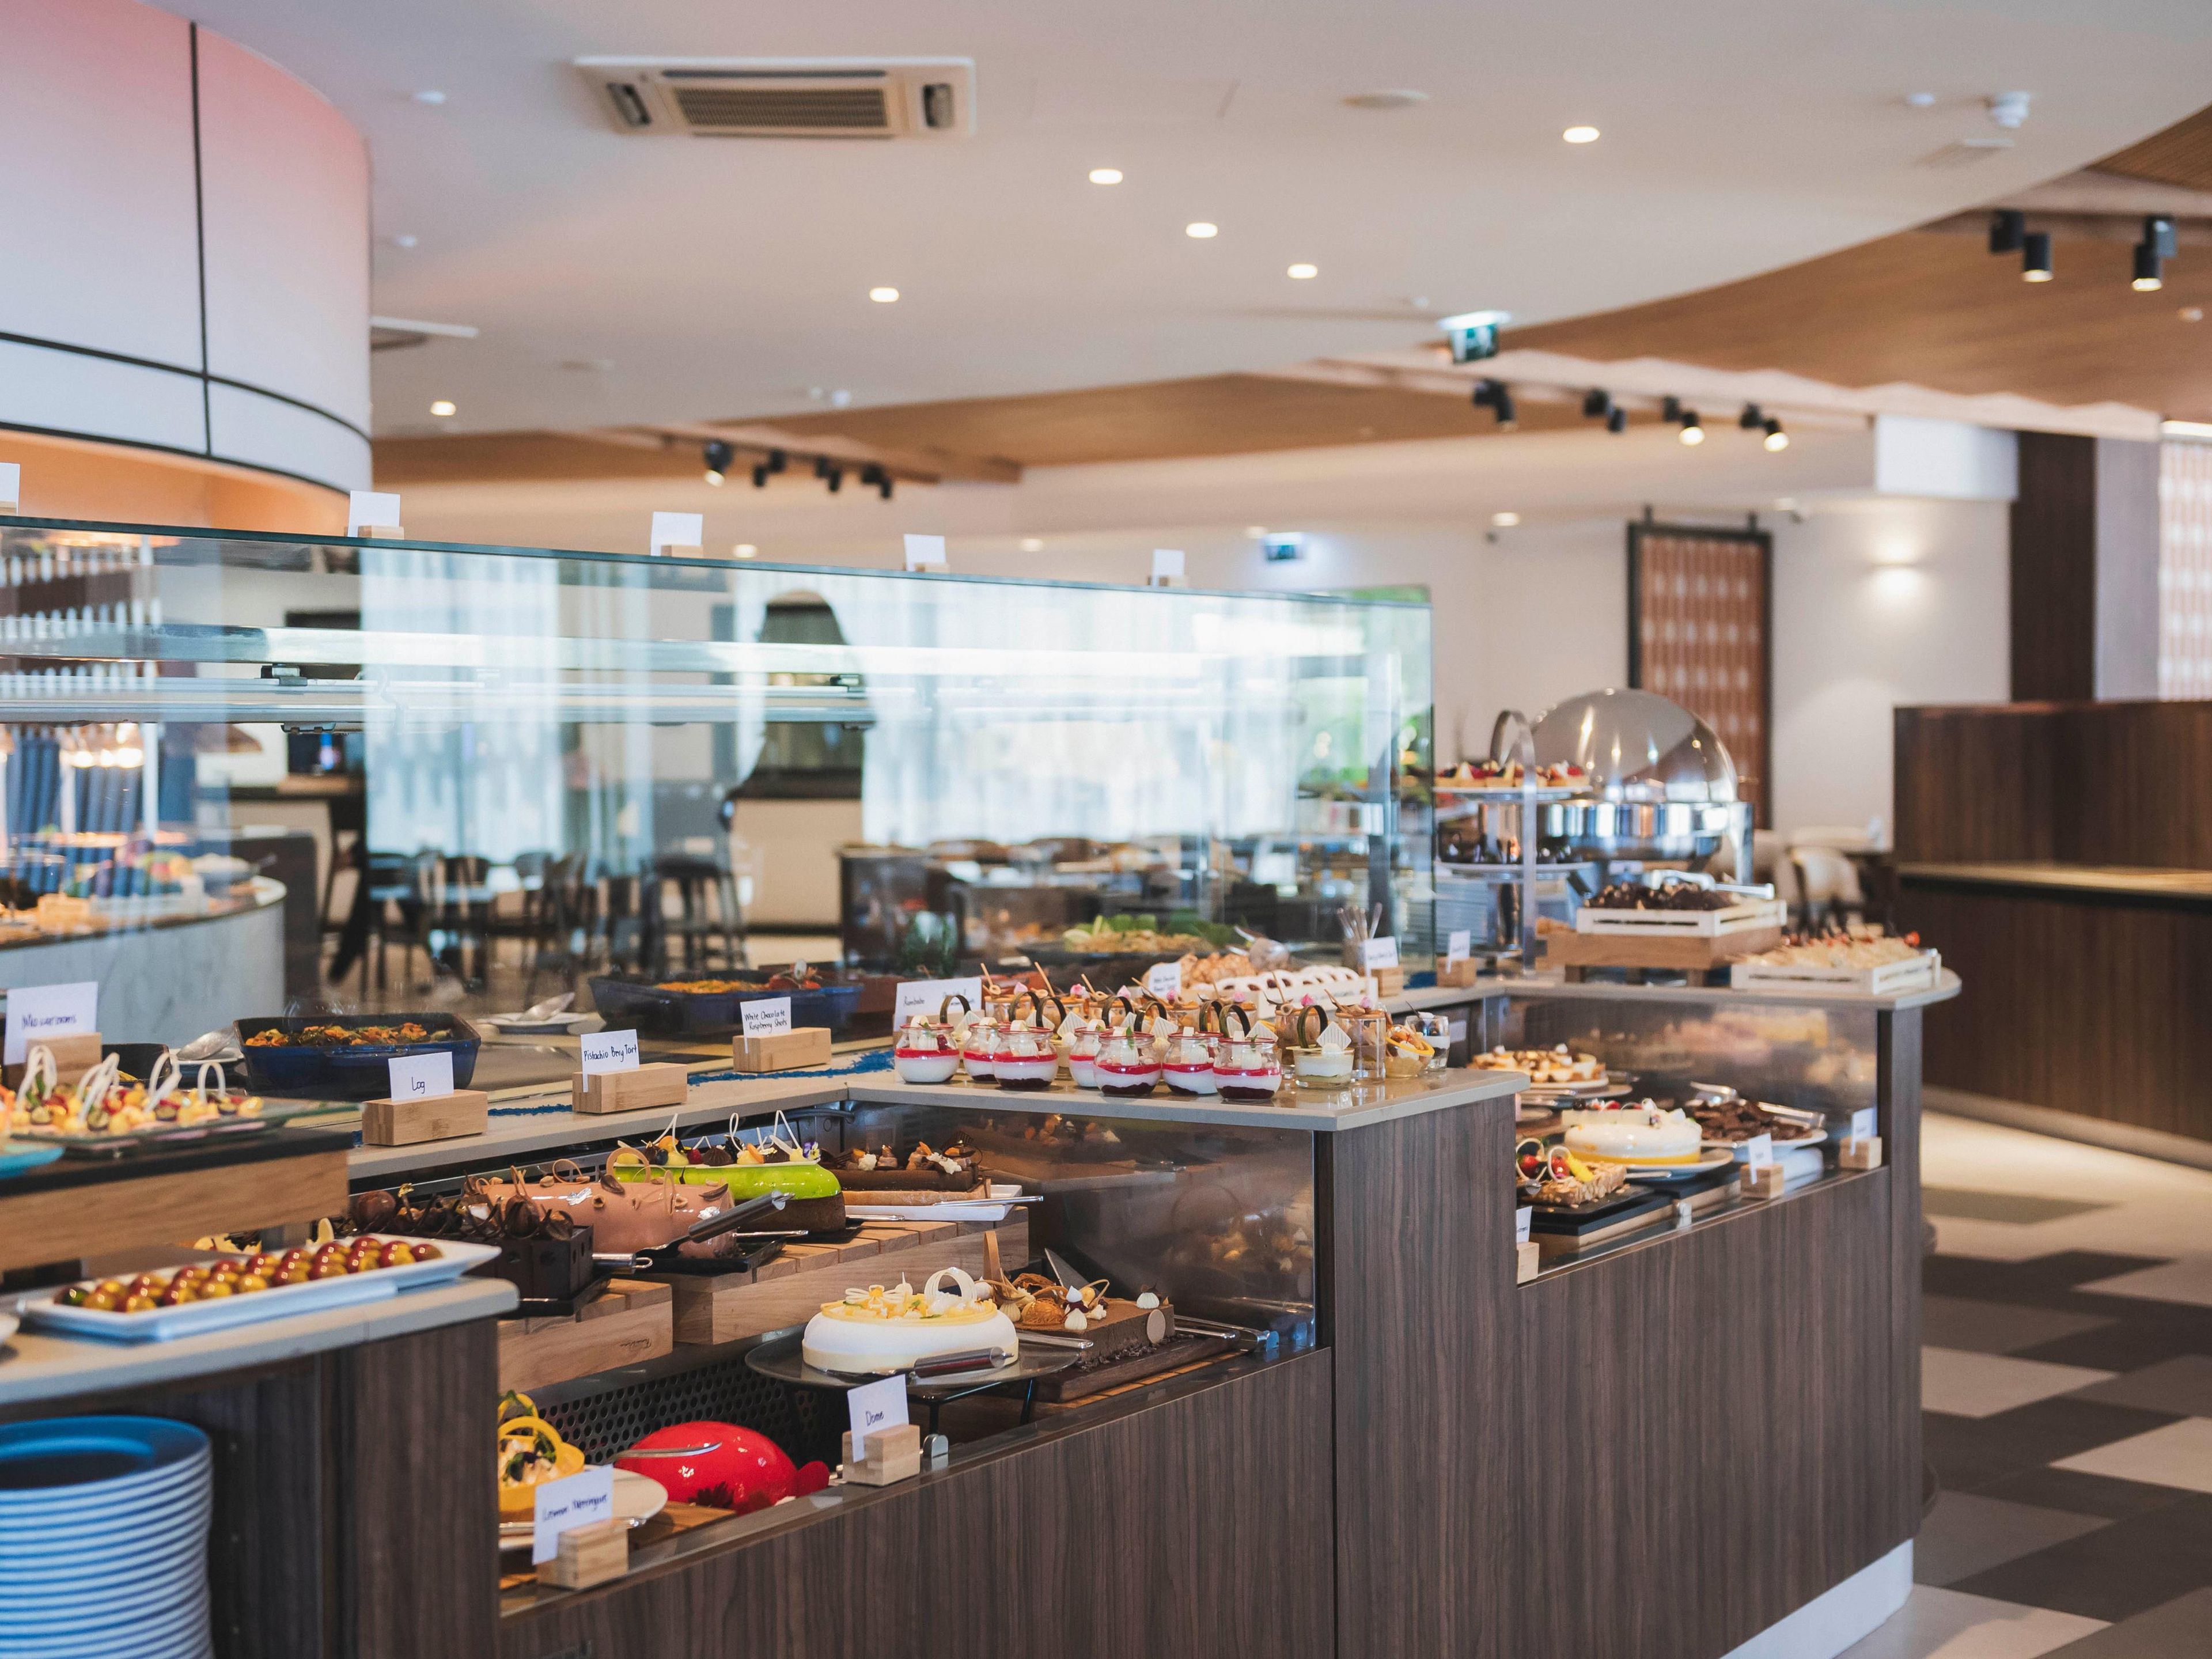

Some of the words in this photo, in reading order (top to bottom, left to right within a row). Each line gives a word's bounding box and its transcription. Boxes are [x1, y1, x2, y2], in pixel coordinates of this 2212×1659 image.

[744, 1012, 759, 1021] White
[760, 1009, 785, 1020] Chocolate
[749, 1021, 772, 1033] Raspberry
[584, 1050, 609, 1061] Pistachio
[624, 1044, 637, 1054] Tart
[411, 1077, 425, 1094] Log
[866, 1410, 885, 1426] Dome
